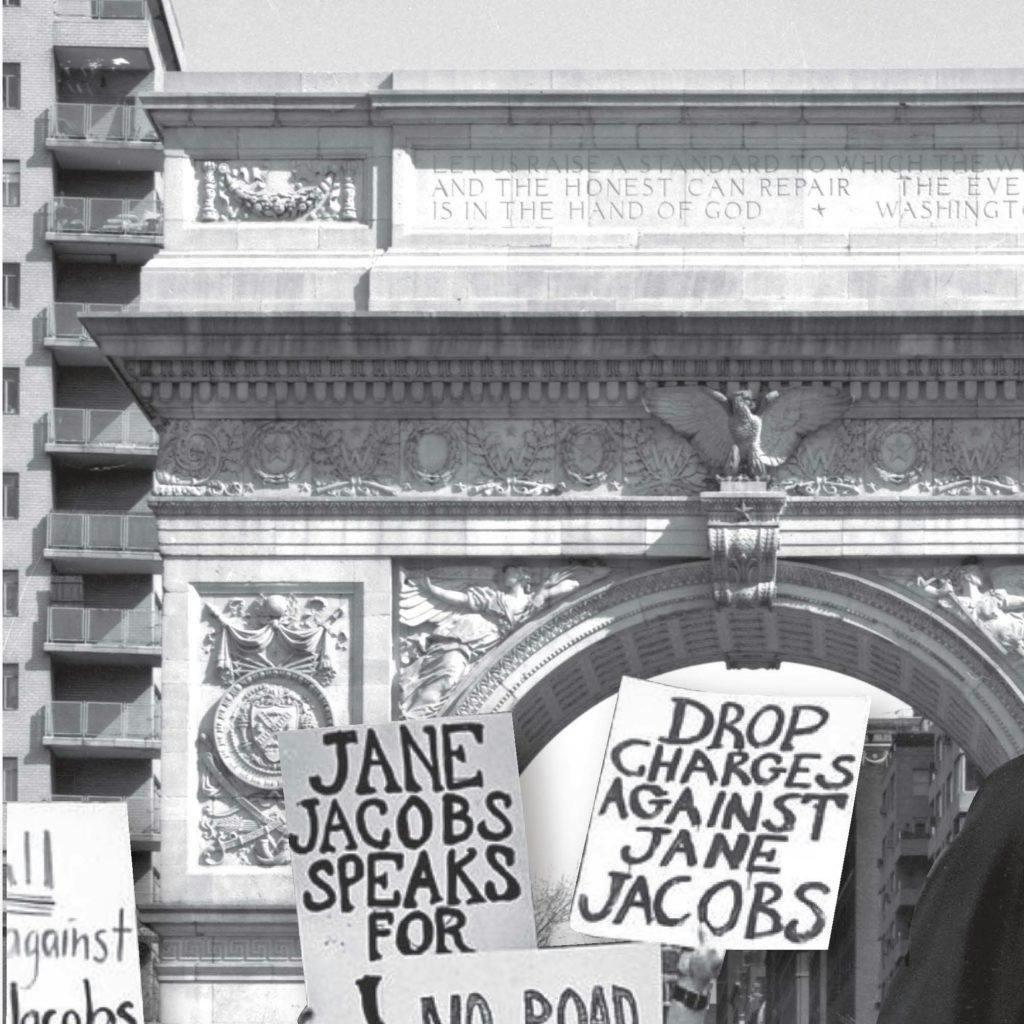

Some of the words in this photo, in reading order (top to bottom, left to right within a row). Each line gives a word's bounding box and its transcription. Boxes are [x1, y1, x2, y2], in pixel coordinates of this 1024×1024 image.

[433, 155, 484, 173] LET
[527, 154, 601, 173] RAISE
[610, 154, 628, 173] A
[640, 154, 779, 173] STANDARD
[793, 154, 826, 173] TO
[837, 154, 922, 173] WHICH
[932, 153, 984, 172] THE
[433, 178, 484, 197] AND
[495, 178, 549, 197] THE
[565, 178, 672, 197] HONEST
[688, 178, 745, 197] CAN
[760, 177, 850, 196] REPAIR
[896, 177, 951, 196] THE
[433, 201, 452, 220] IS
[465, 201, 487, 220] IN
[501, 201, 553, 220] THE
[569, 201, 643, 220] HAND
[657, 201, 693, 220] OF
[705, 201, 761, 220] GOD
[658, 697, 829, 751] DROP
[308, 722, 484, 796] JANE
[610, 738, 857, 790] CHARGES
[288, 790, 513, 854] JACOBS
[598, 777, 850, 841] AGAINST
[620, 826, 789, 874] JANE
[302, 843, 521, 913] SPEAKS
[368, 905, 477, 962] FOR
[578, 871, 831, 944] JACOBS
